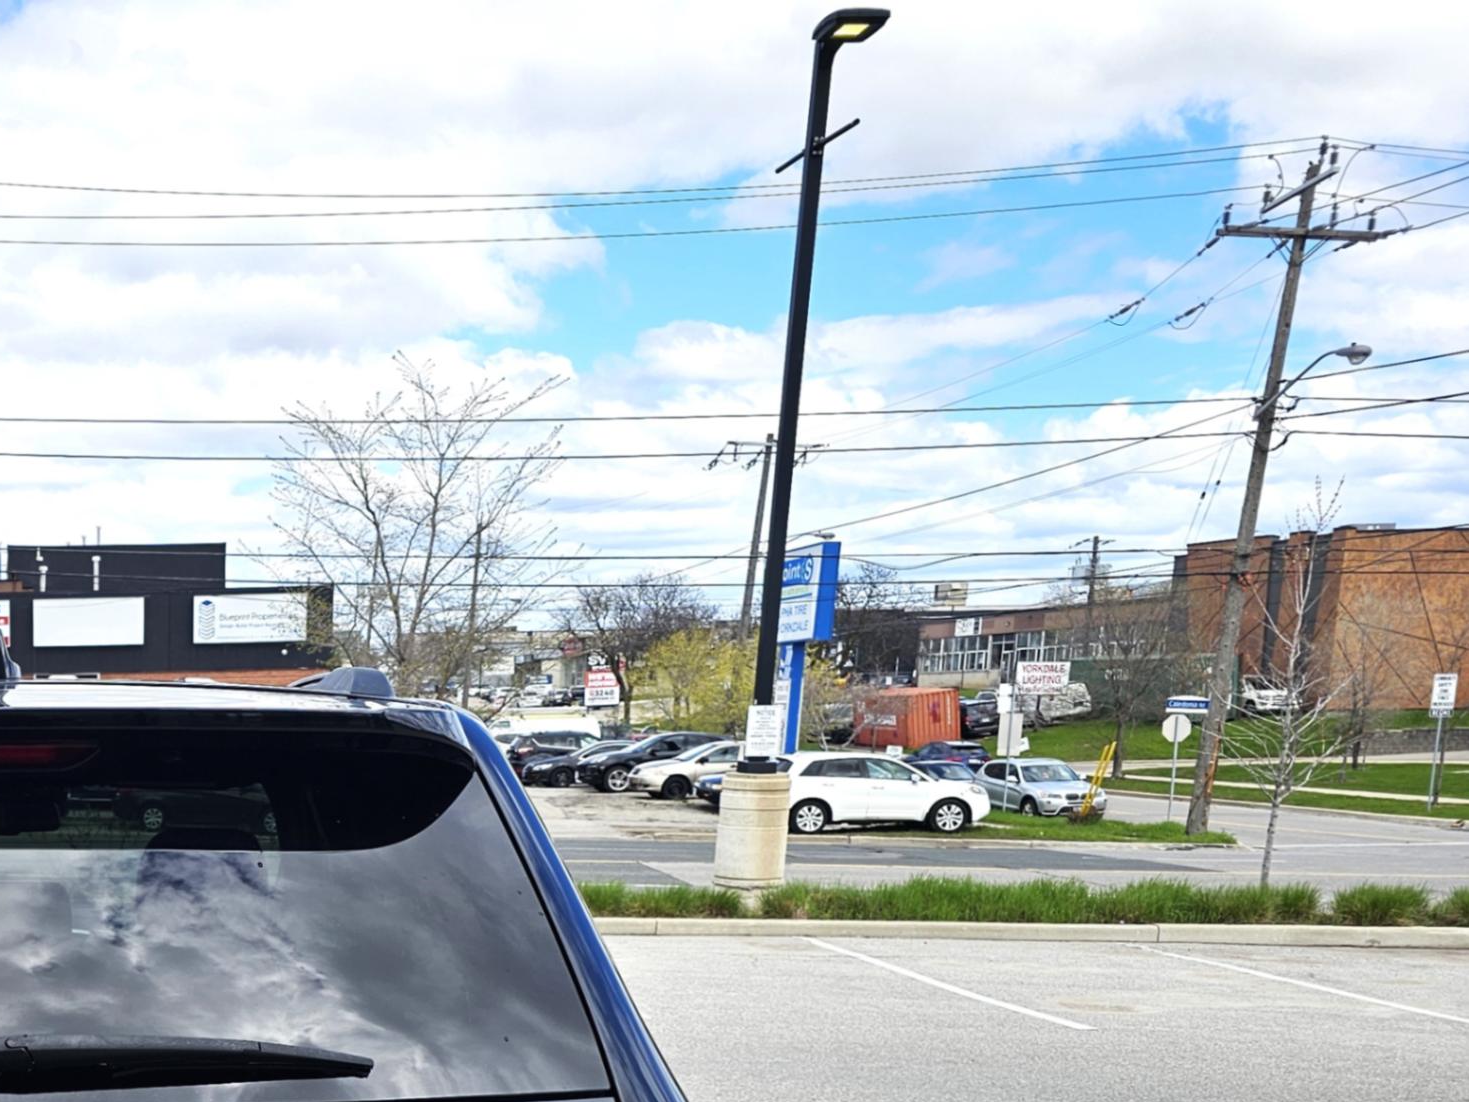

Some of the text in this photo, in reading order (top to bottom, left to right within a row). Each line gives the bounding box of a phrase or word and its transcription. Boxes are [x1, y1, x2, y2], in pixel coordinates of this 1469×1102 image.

[782, 562, 802, 583] oint
[1021, 663, 1067, 674] YORKDALE
[1022, 675, 1061, 685] LIGHTING
